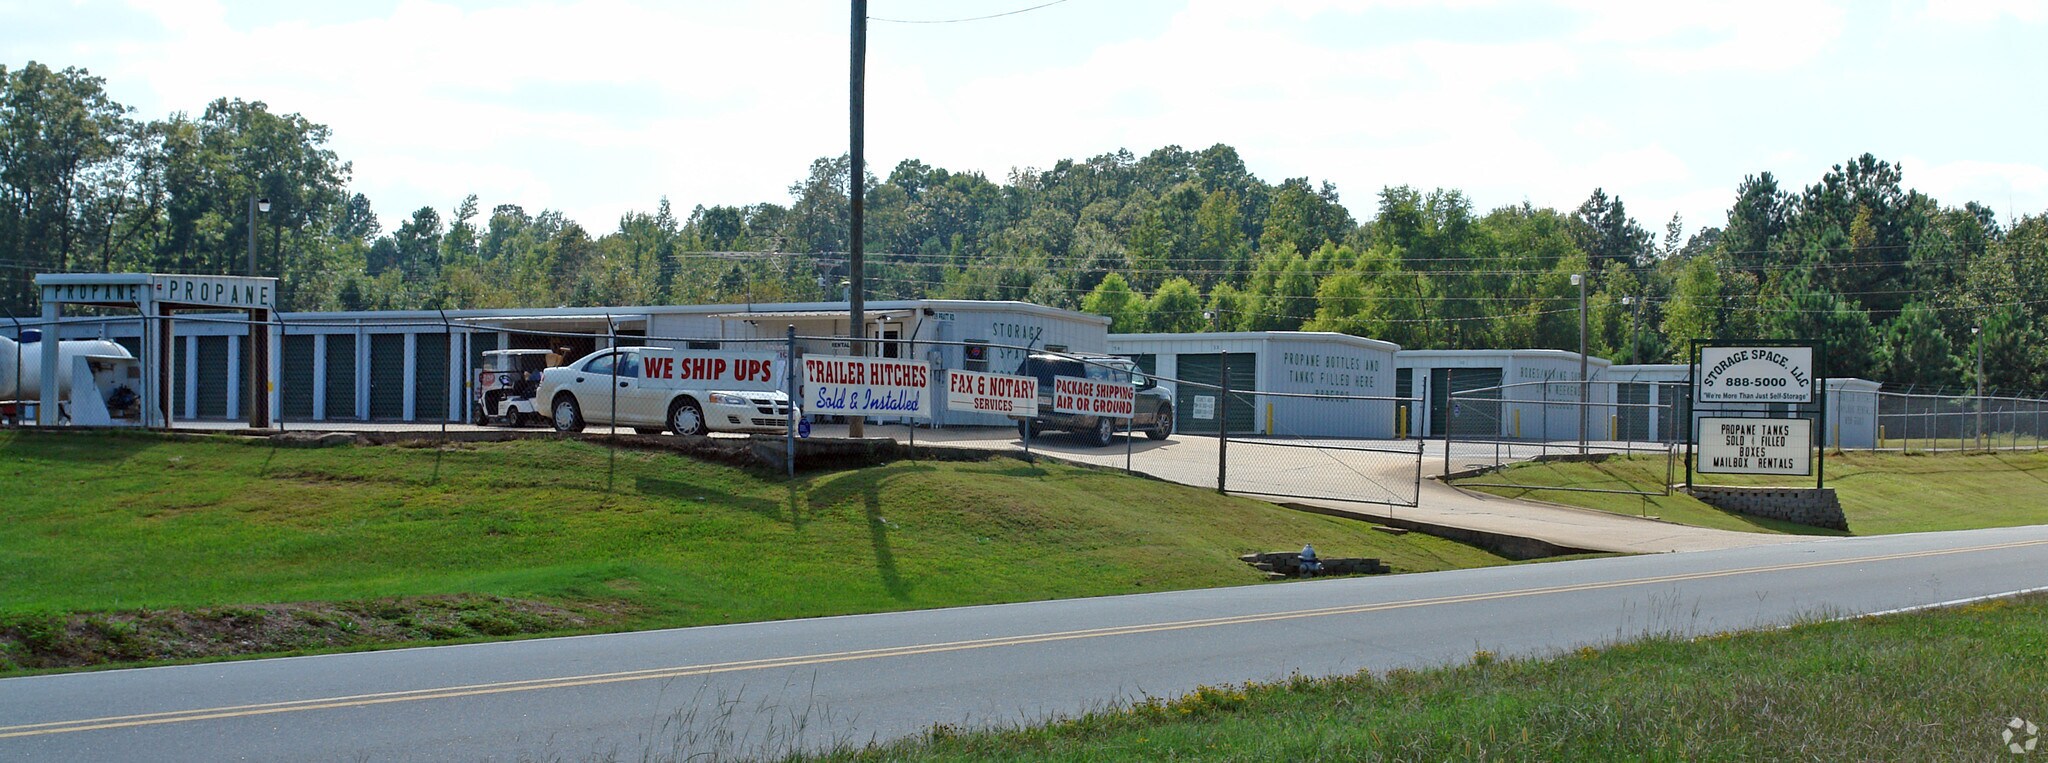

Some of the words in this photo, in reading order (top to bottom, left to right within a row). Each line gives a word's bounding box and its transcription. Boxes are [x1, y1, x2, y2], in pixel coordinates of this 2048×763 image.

[55, 284, 136, 299] PROPANE
[167, 280, 268, 305] PROPANE
[993, 322, 1040, 340] STORAGE
[644, 357, 674, 379] WE
[681, 358, 726, 380] SHIP
[734, 359, 771, 382] UPS
[1284, 352, 1319, 367] PROPANE
[1326, 356, 1360, 370] BOTTLES
[1366, 360, 1378, 372] AND
[1704, 350, 1748, 387] STORAGE
[1790, 366, 1809, 388] LLC
[806, 360, 865, 384] TRAILER
[870, 363, 926, 388] HITCHES
[1290, 370, 1314, 384] TANKS
[1320, 372, 1350, 386] FILLED
[1356, 376, 1374, 388] HERE
[1726, 378, 1786, 386] 888-5000
[951, 374, 974, 394] FAX
[978, 376, 985, 395] &
[990, 377, 1034, 399] NOTARY
[1056, 379, 1093, 396] PACKAGE
[1096, 384, 1134, 400] SHIPPING
[816, 387, 845, 409] Sold
[850, 392, 858, 410] &
[862, 388, 919, 411] Installed
[974, 398, 1012, 411] SERVICES
[1056, 395, 1073, 410] AIR
[1076, 398, 1090, 411] OR
[1093, 399, 1132, 414] GROUND
[1721, 424, 1756, 435] PROPANE
[1762, 425, 1789, 436] TANKS
[1726, 436, 1744, 446] SOLD
[1761, 436, 1786, 446] FILLED
[1740, 447, 1766, 457] BOXES
[1714, 457, 1748, 468] MAILBOX
[1758, 458, 1794, 468] RENTALS
